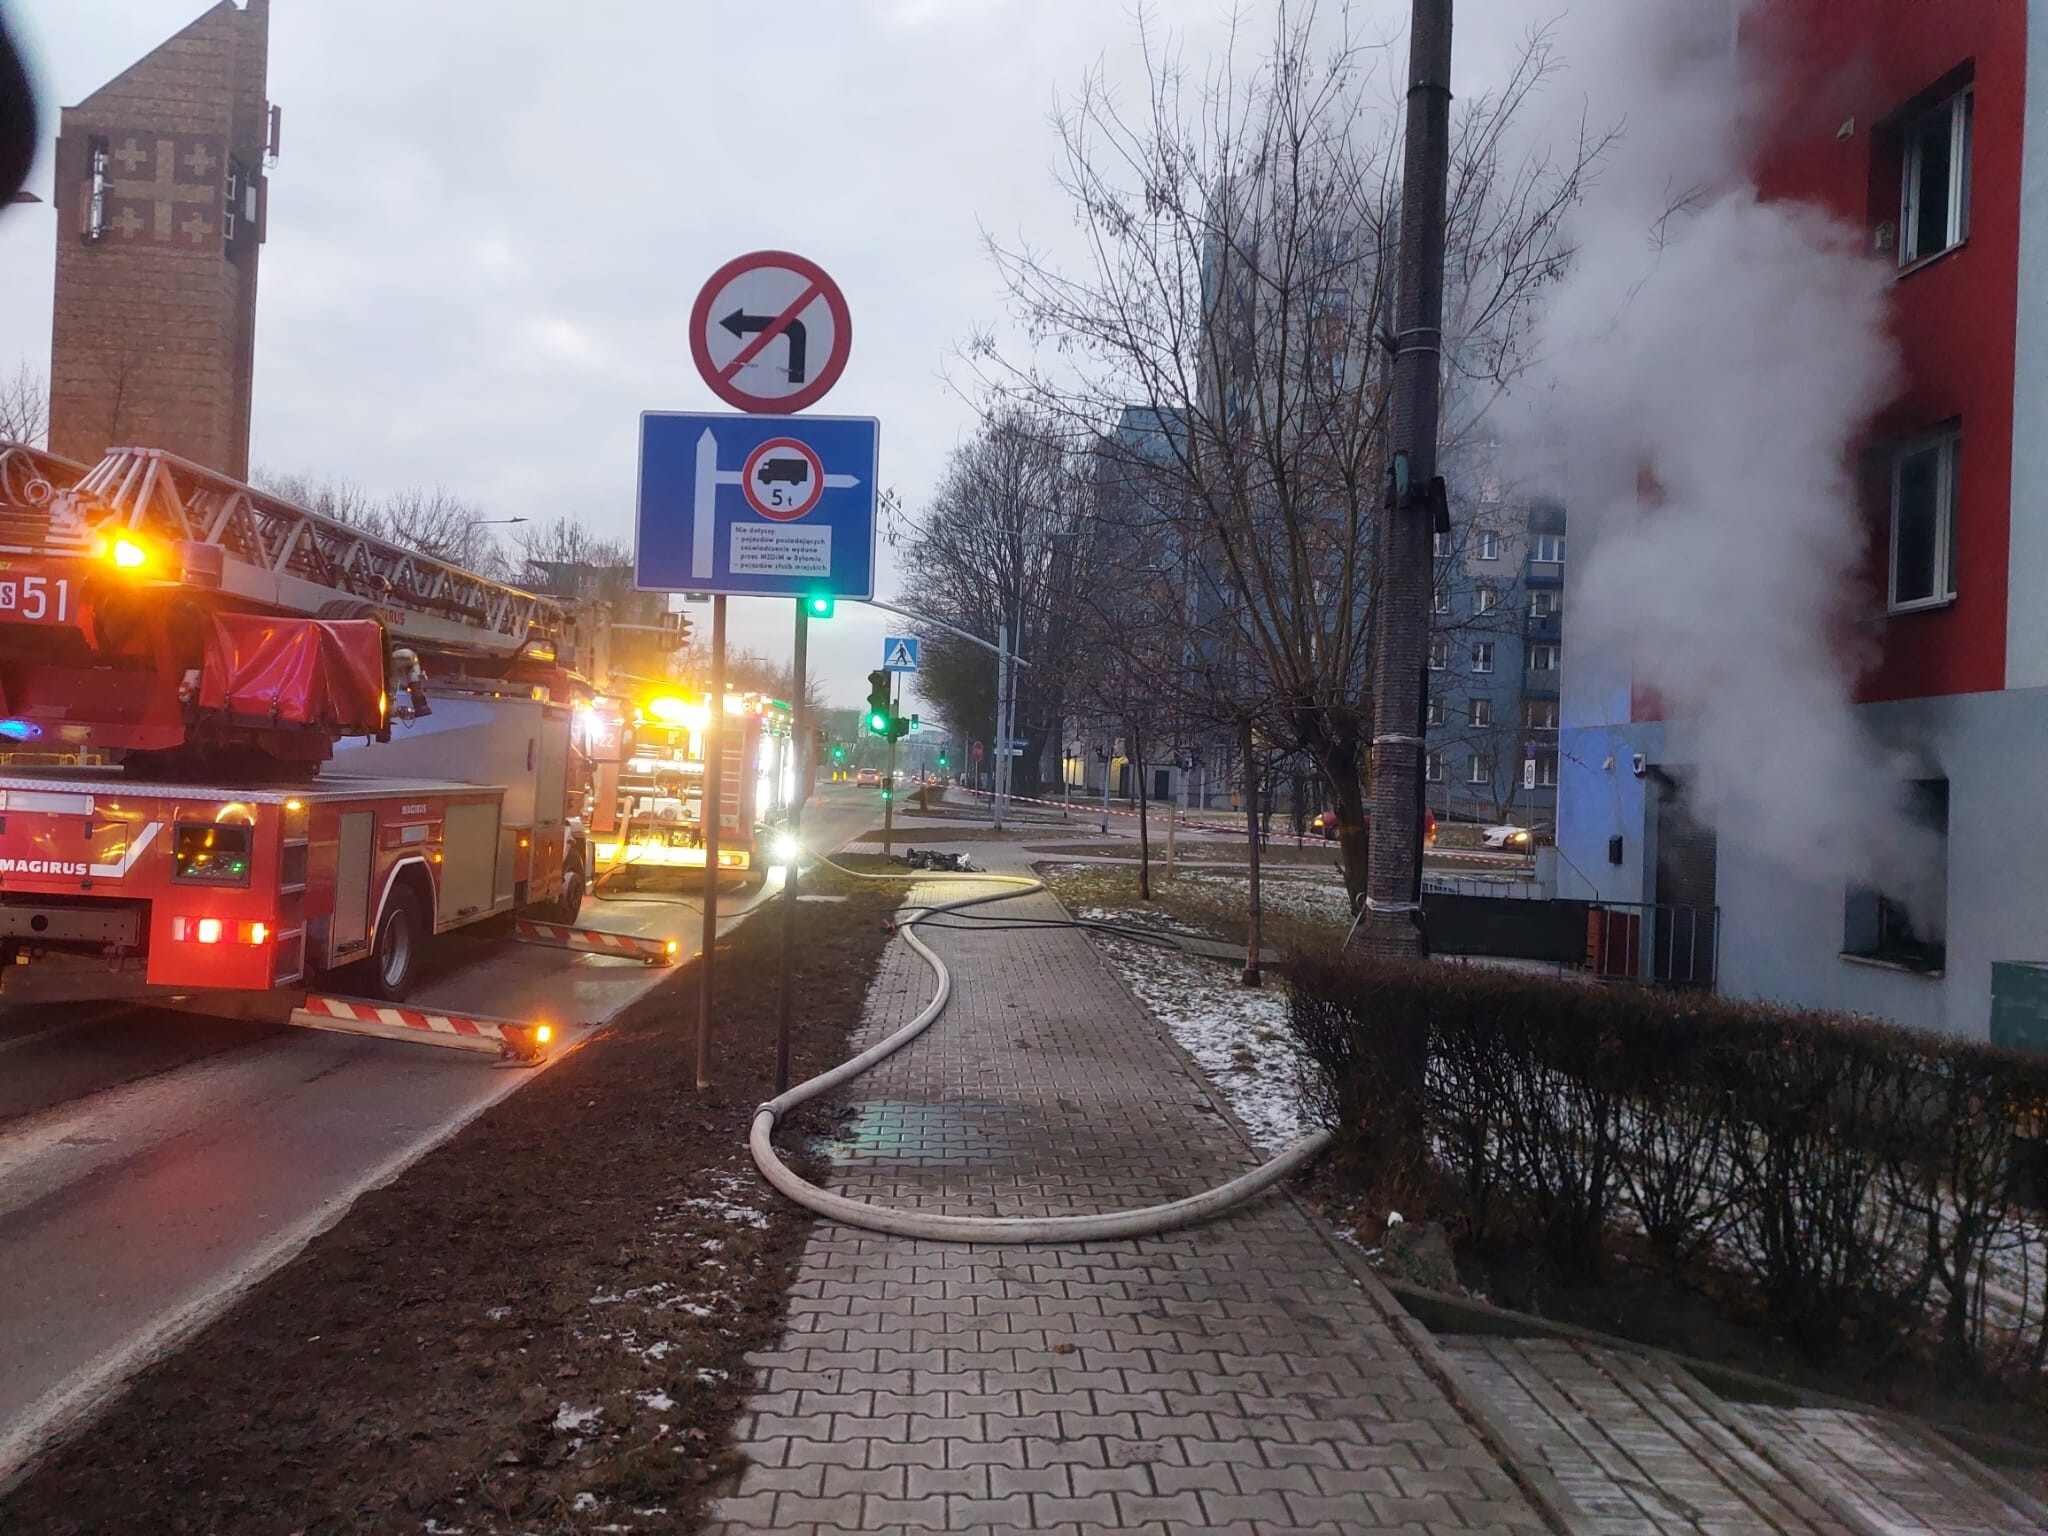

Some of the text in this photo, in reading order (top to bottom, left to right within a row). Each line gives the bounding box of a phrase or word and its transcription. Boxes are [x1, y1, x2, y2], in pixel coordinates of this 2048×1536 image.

[772, 489, 793, 507] 5 t
[1, 576, 68, 622] S 51
[0, 859, 87, 876] MAGIRUS
